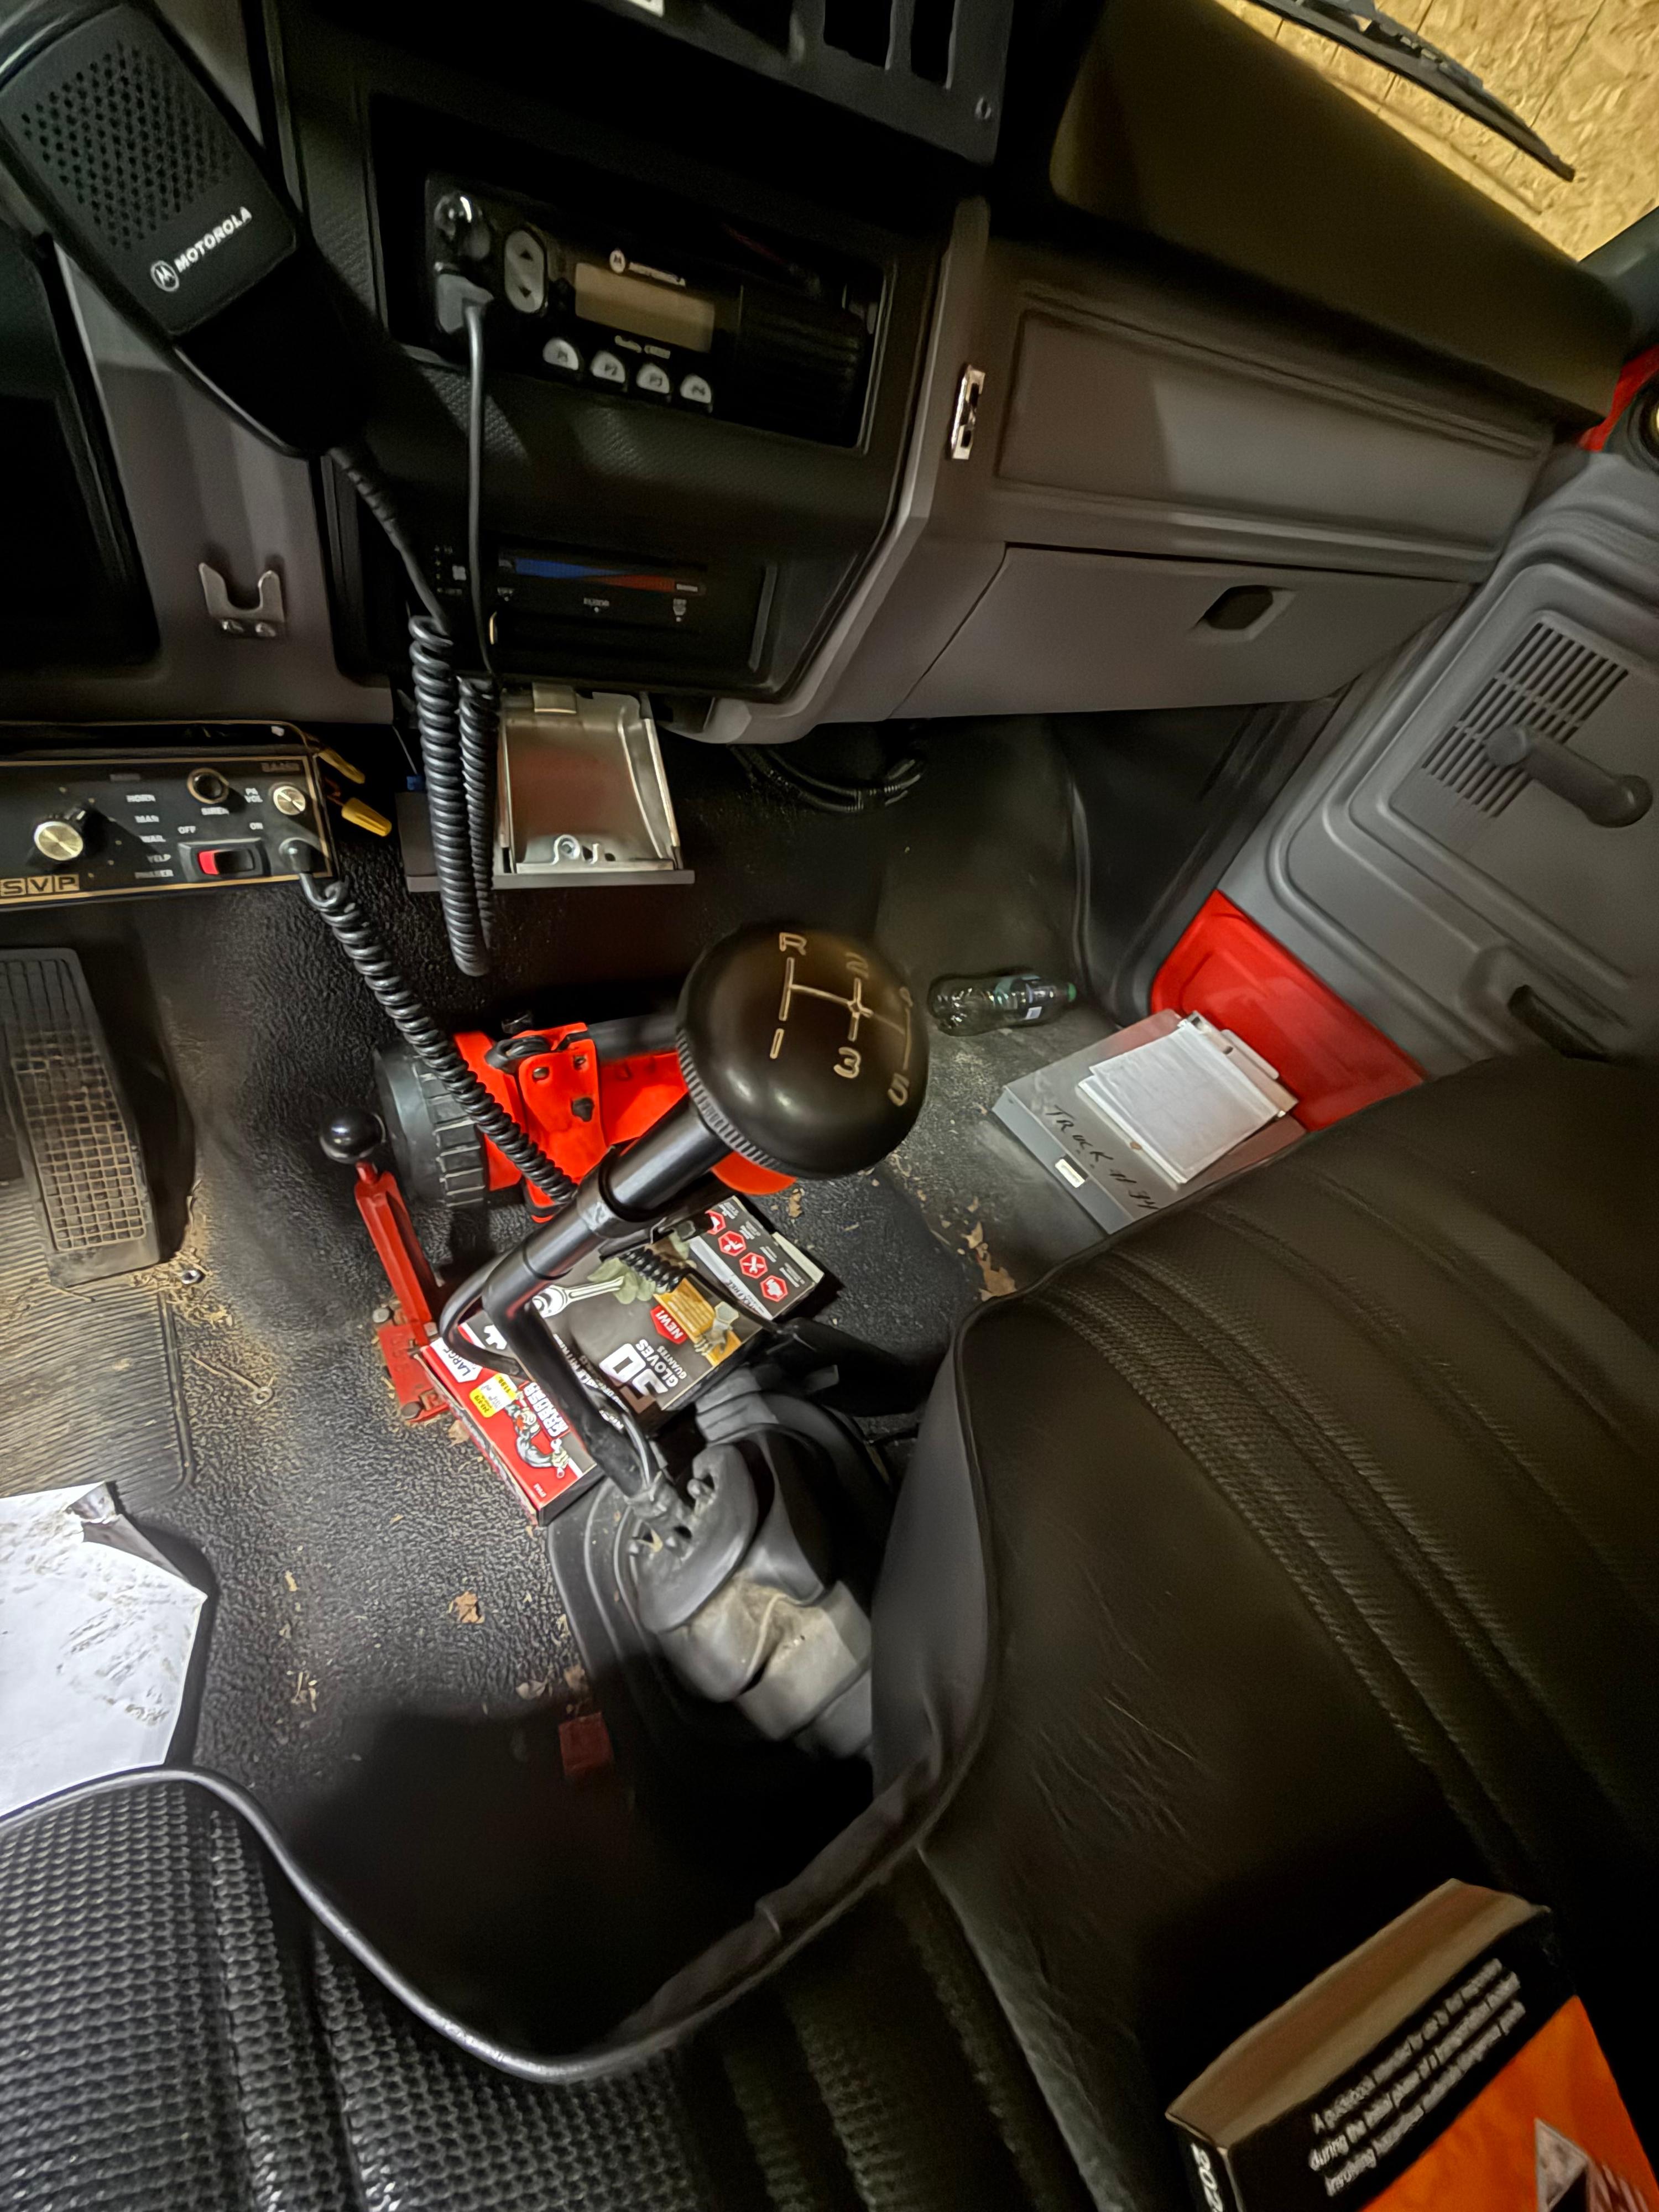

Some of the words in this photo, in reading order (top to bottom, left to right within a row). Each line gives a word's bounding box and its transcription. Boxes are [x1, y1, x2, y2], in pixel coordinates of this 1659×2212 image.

[174, 206, 253, 273] MOTOROLA
[178, 826, 196, 834] OFF
[2, 877, 76, 895] SVP
[779, 932, 807, 956] R
[833, 1047, 862, 1079] 3
[888, 1072, 910, 1106] 5
[1046, 1105, 1114, 1162] TRUCK
[656, 1310, 683, 1338] NEW!
[599, 1343, 668, 1413] 50
[636, 1339, 679, 1387] GLOVES
[657, 1345, 687, 1380] GUANTES
